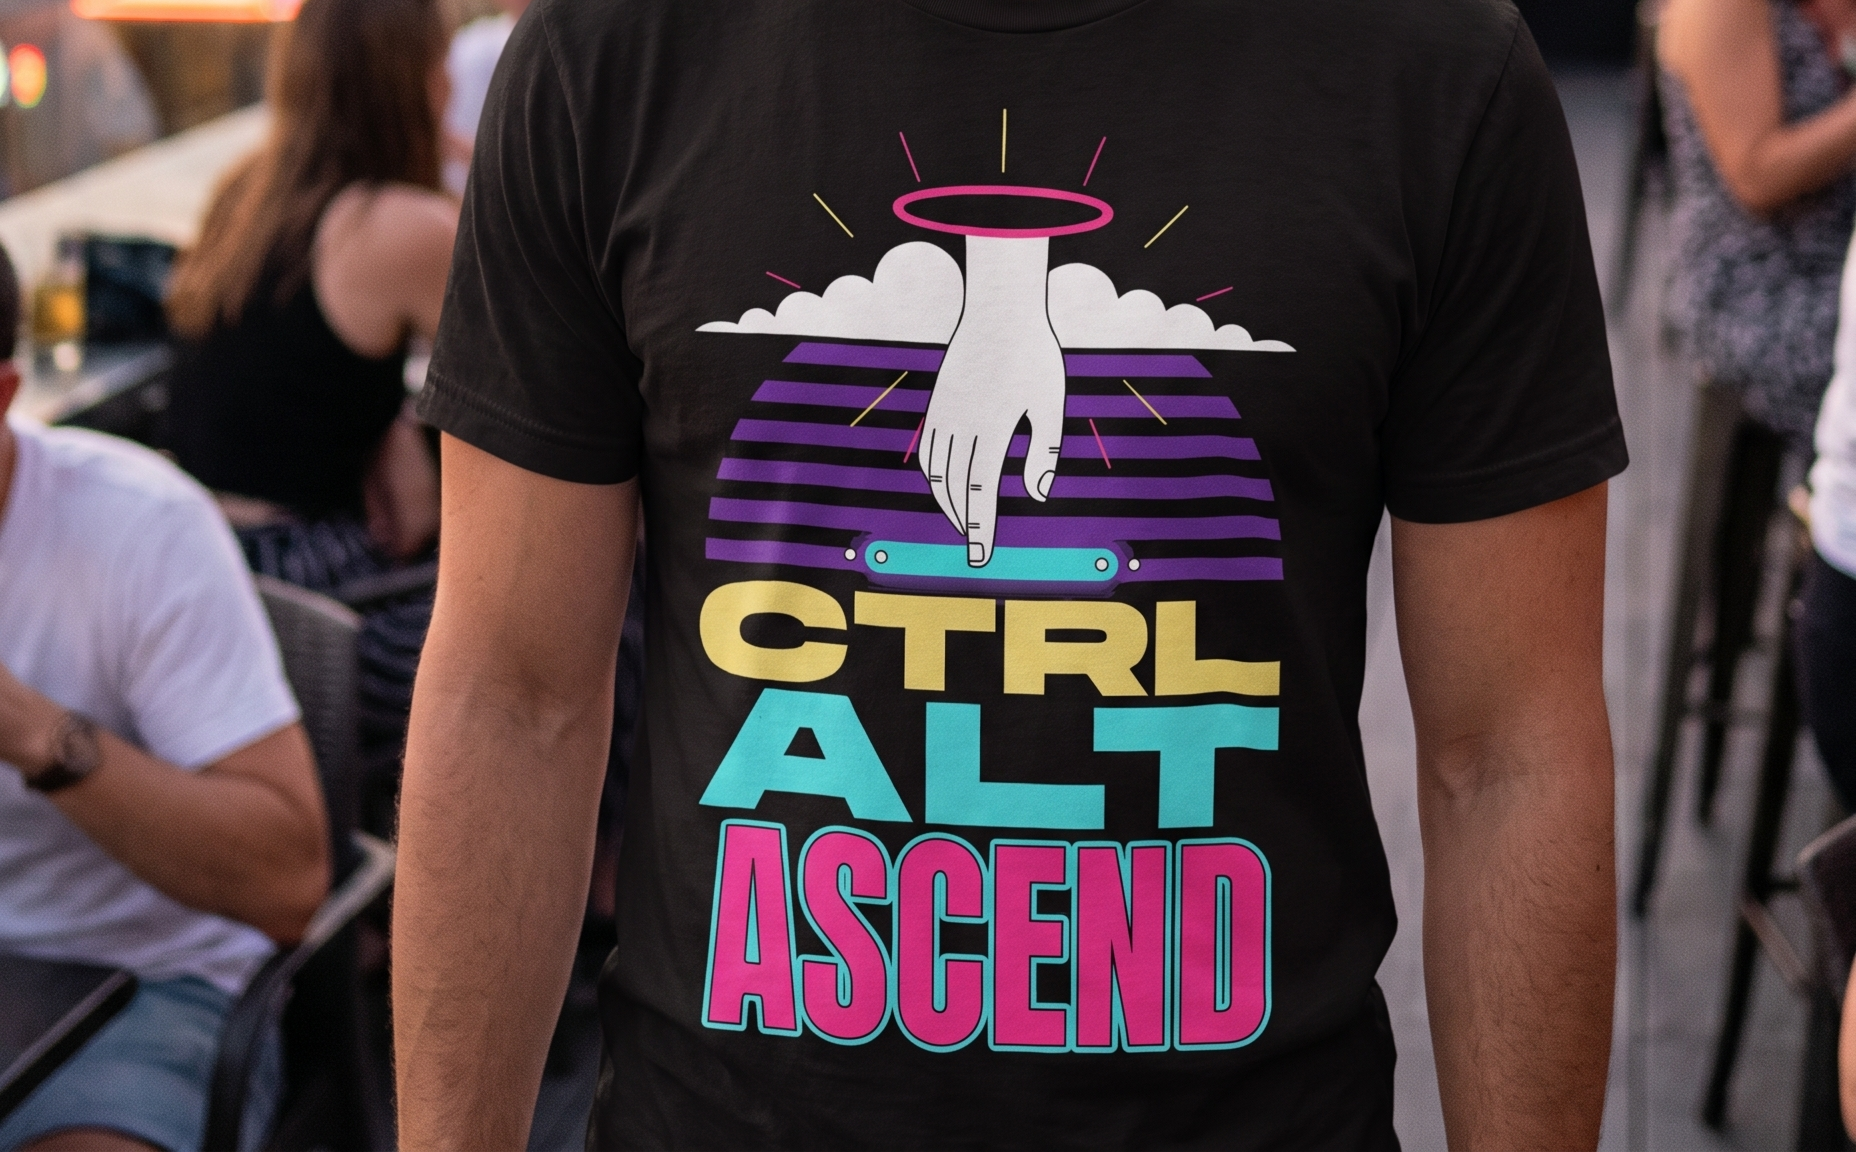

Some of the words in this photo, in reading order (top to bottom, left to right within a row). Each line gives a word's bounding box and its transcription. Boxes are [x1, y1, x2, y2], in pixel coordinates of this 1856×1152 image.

[699, 580, 1280, 696] CTRL
[699, 688, 1280, 829] ALT
[701, 819, 1272, 1053] ASCEND
